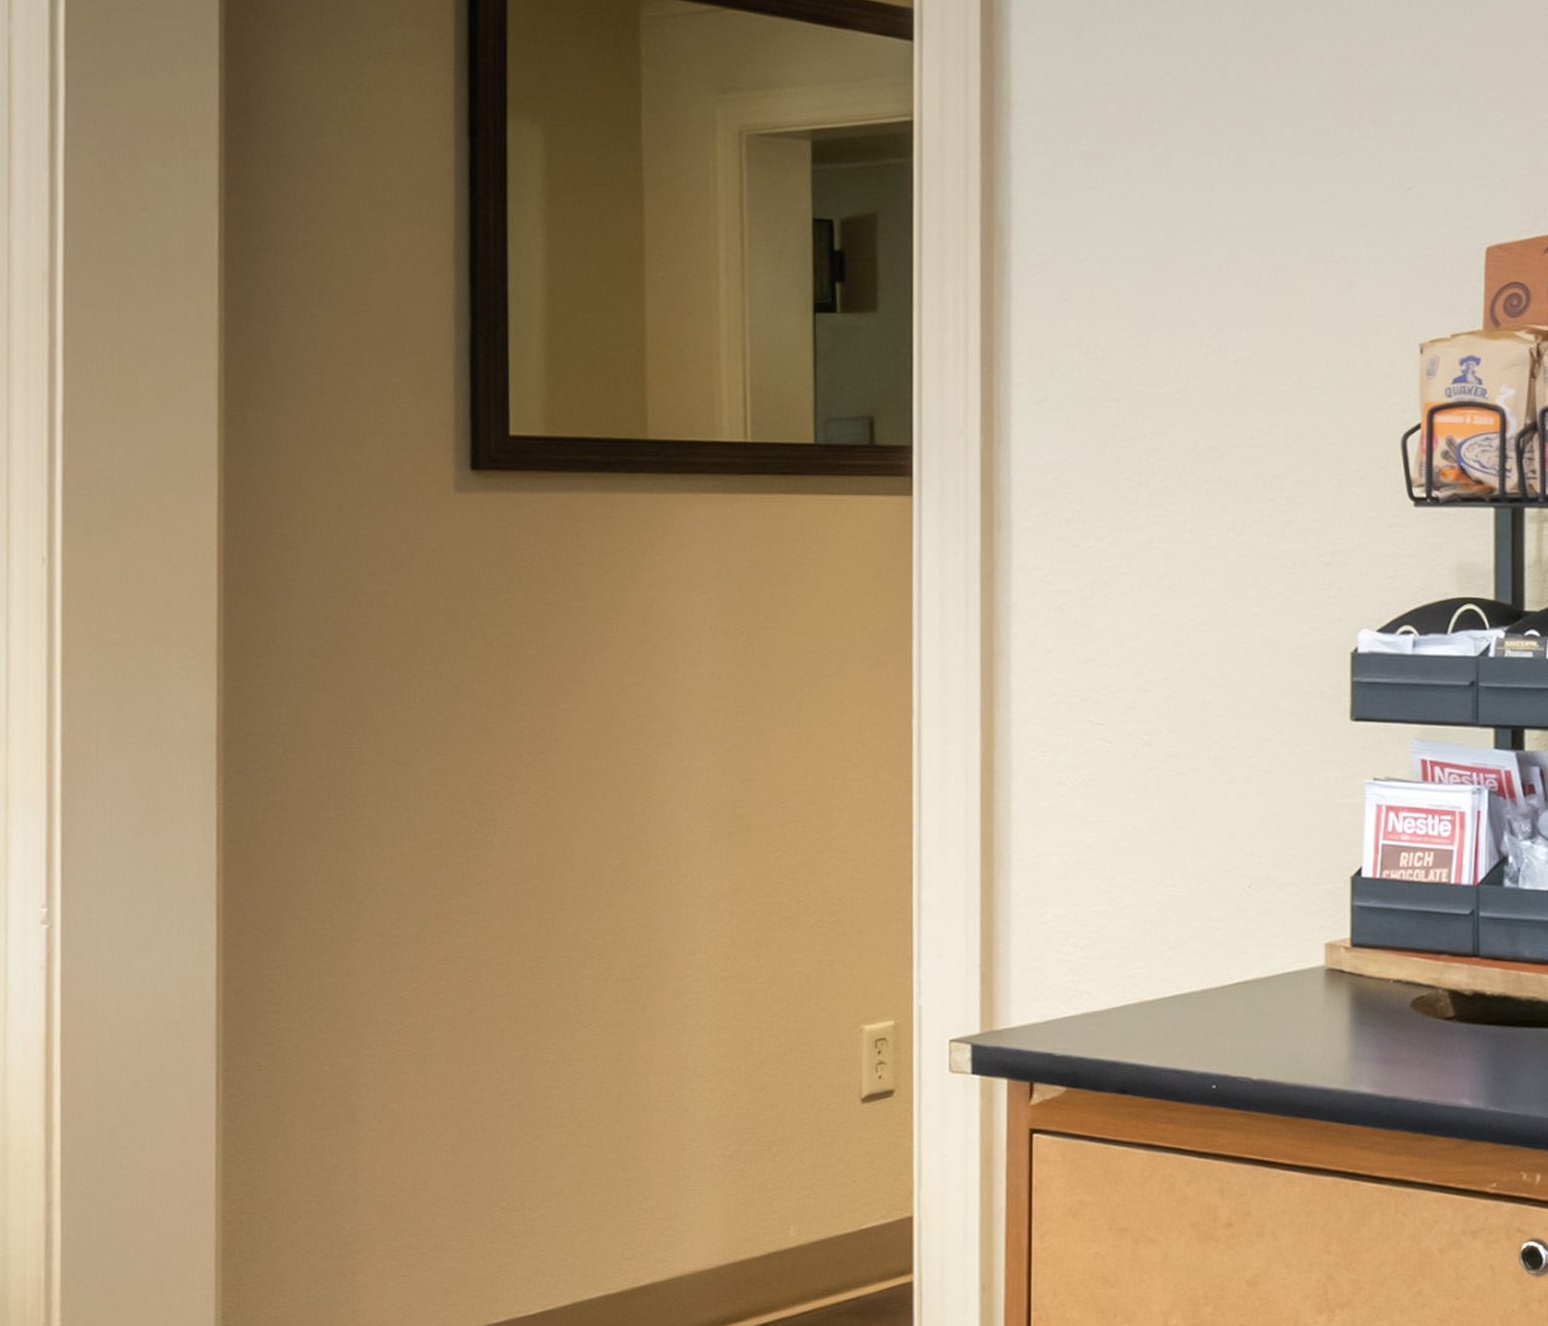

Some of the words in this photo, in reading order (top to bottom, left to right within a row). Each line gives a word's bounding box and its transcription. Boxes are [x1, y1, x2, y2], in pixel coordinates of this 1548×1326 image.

[1444, 385, 1488, 399] QUAKER
[1399, 851, 1434, 868] RICH
[1381, 868, 1449, 883] CHOCOLATE
